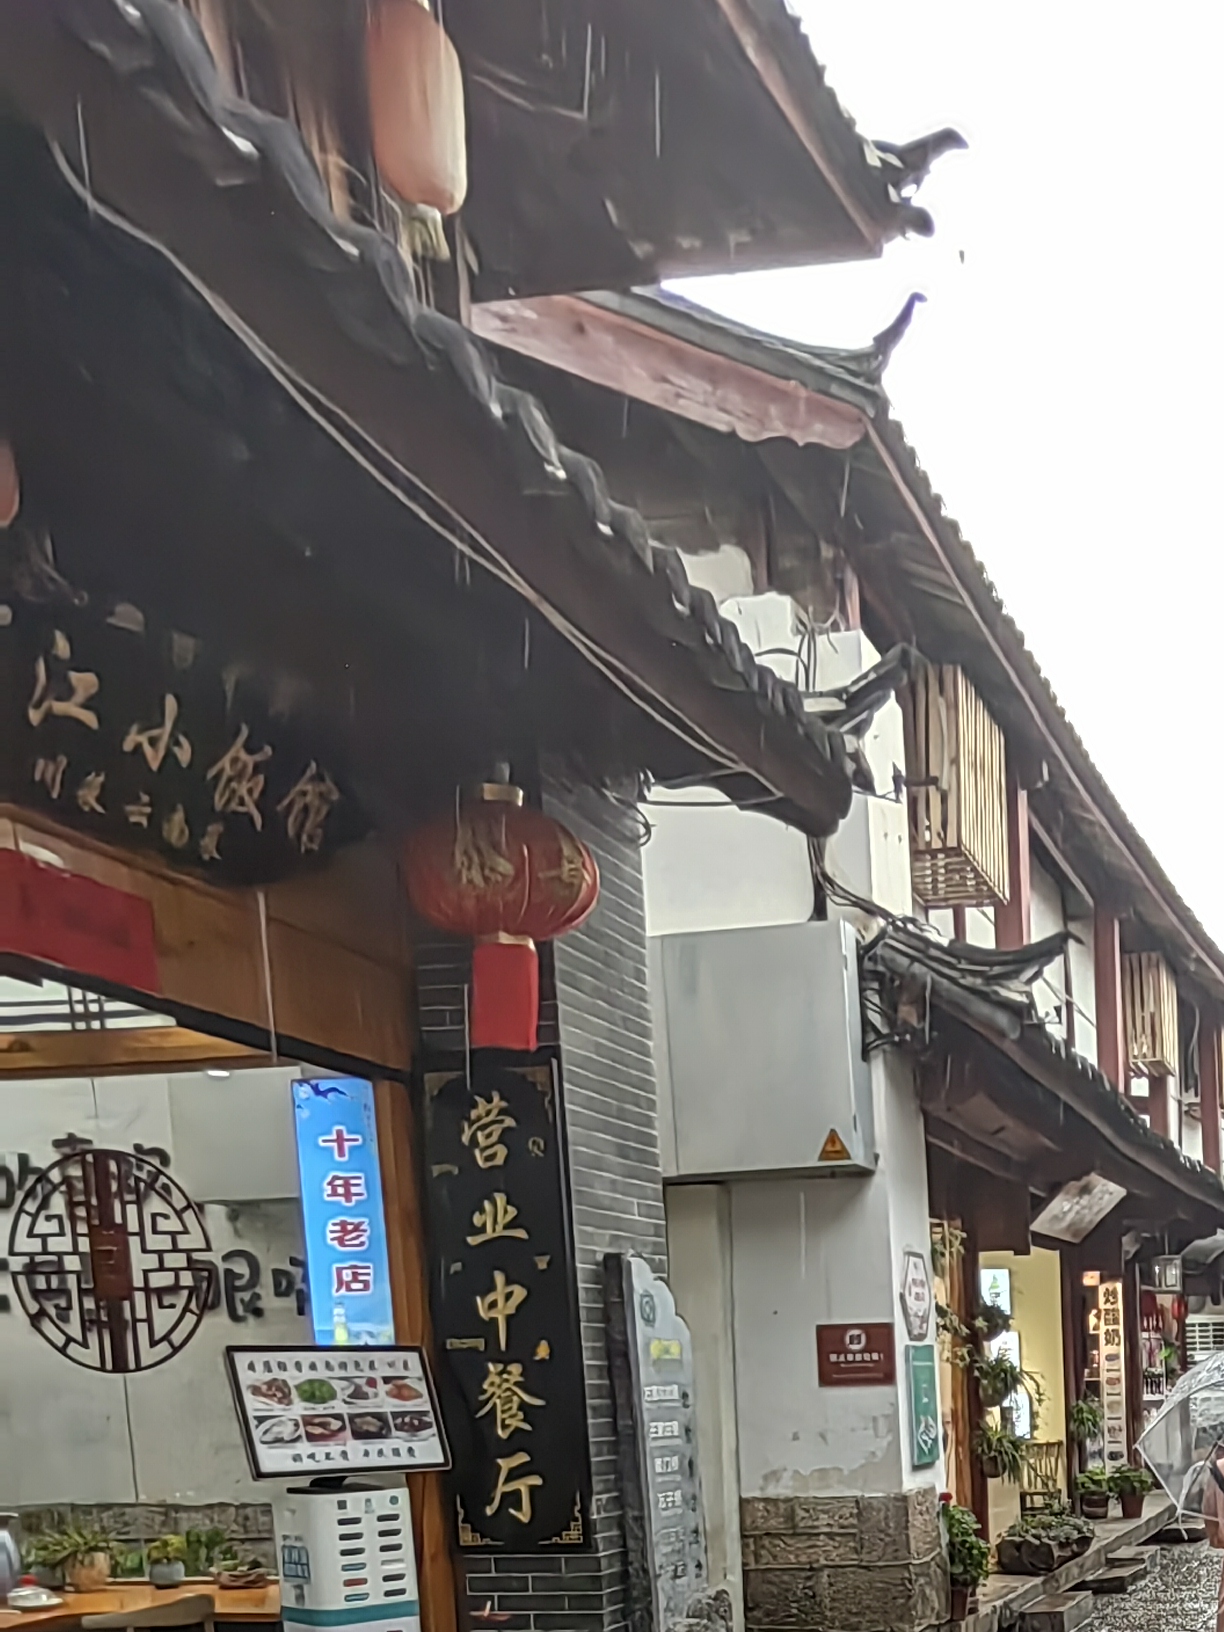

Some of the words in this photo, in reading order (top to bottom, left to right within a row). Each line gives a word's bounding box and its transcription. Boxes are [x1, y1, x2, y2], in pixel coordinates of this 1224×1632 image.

[318, 1126, 373, 1295] 十年老店
[461, 1090, 546, 1525] 营业中餐厅
